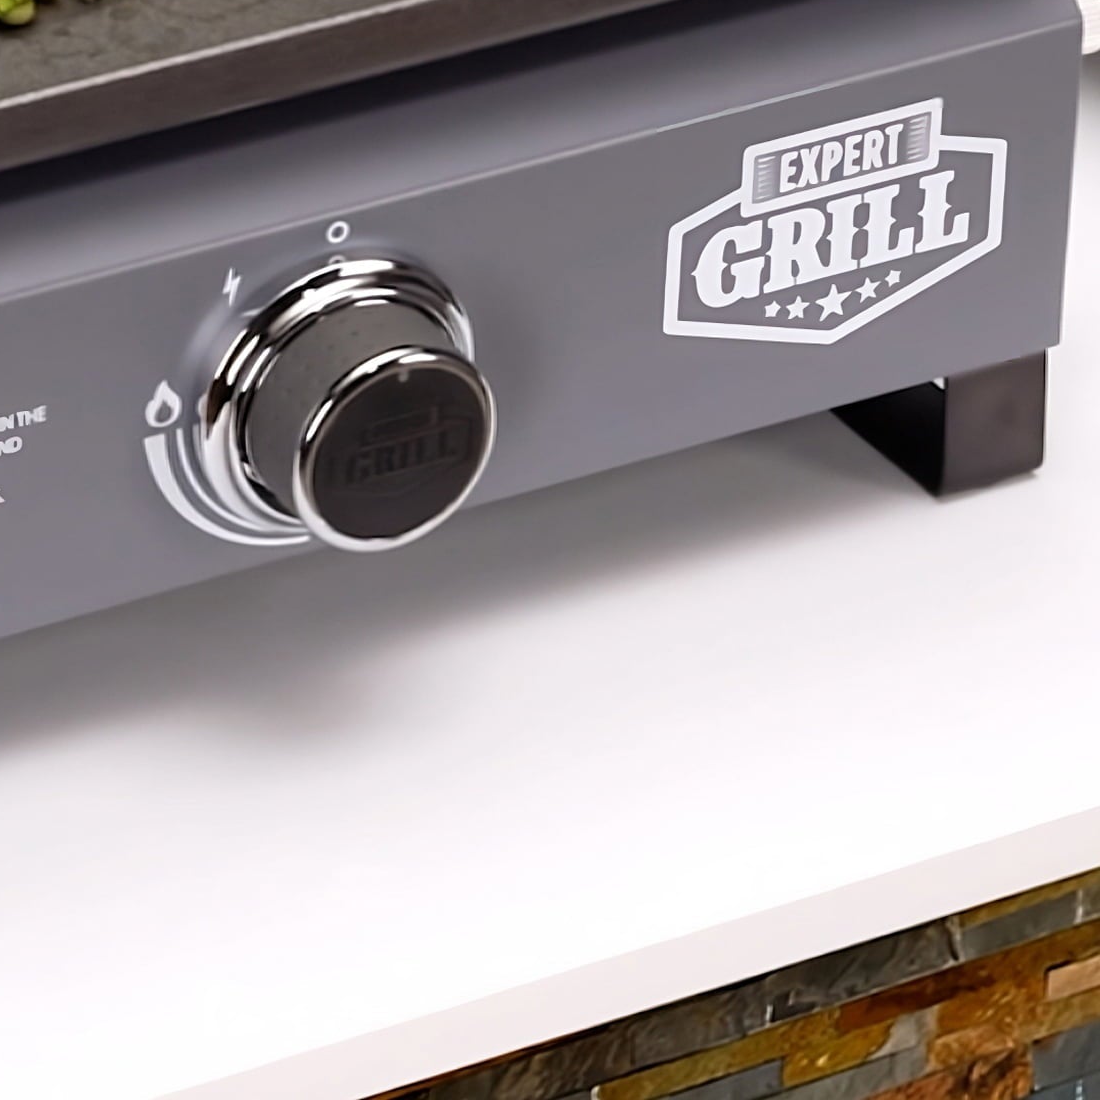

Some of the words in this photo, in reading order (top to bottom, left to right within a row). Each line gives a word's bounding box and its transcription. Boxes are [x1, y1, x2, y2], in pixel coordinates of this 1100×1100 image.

[779, 123, 904, 194] EXPERT
[690, 170, 970, 308] GRILL
[16, 405, 48, 427] THE
